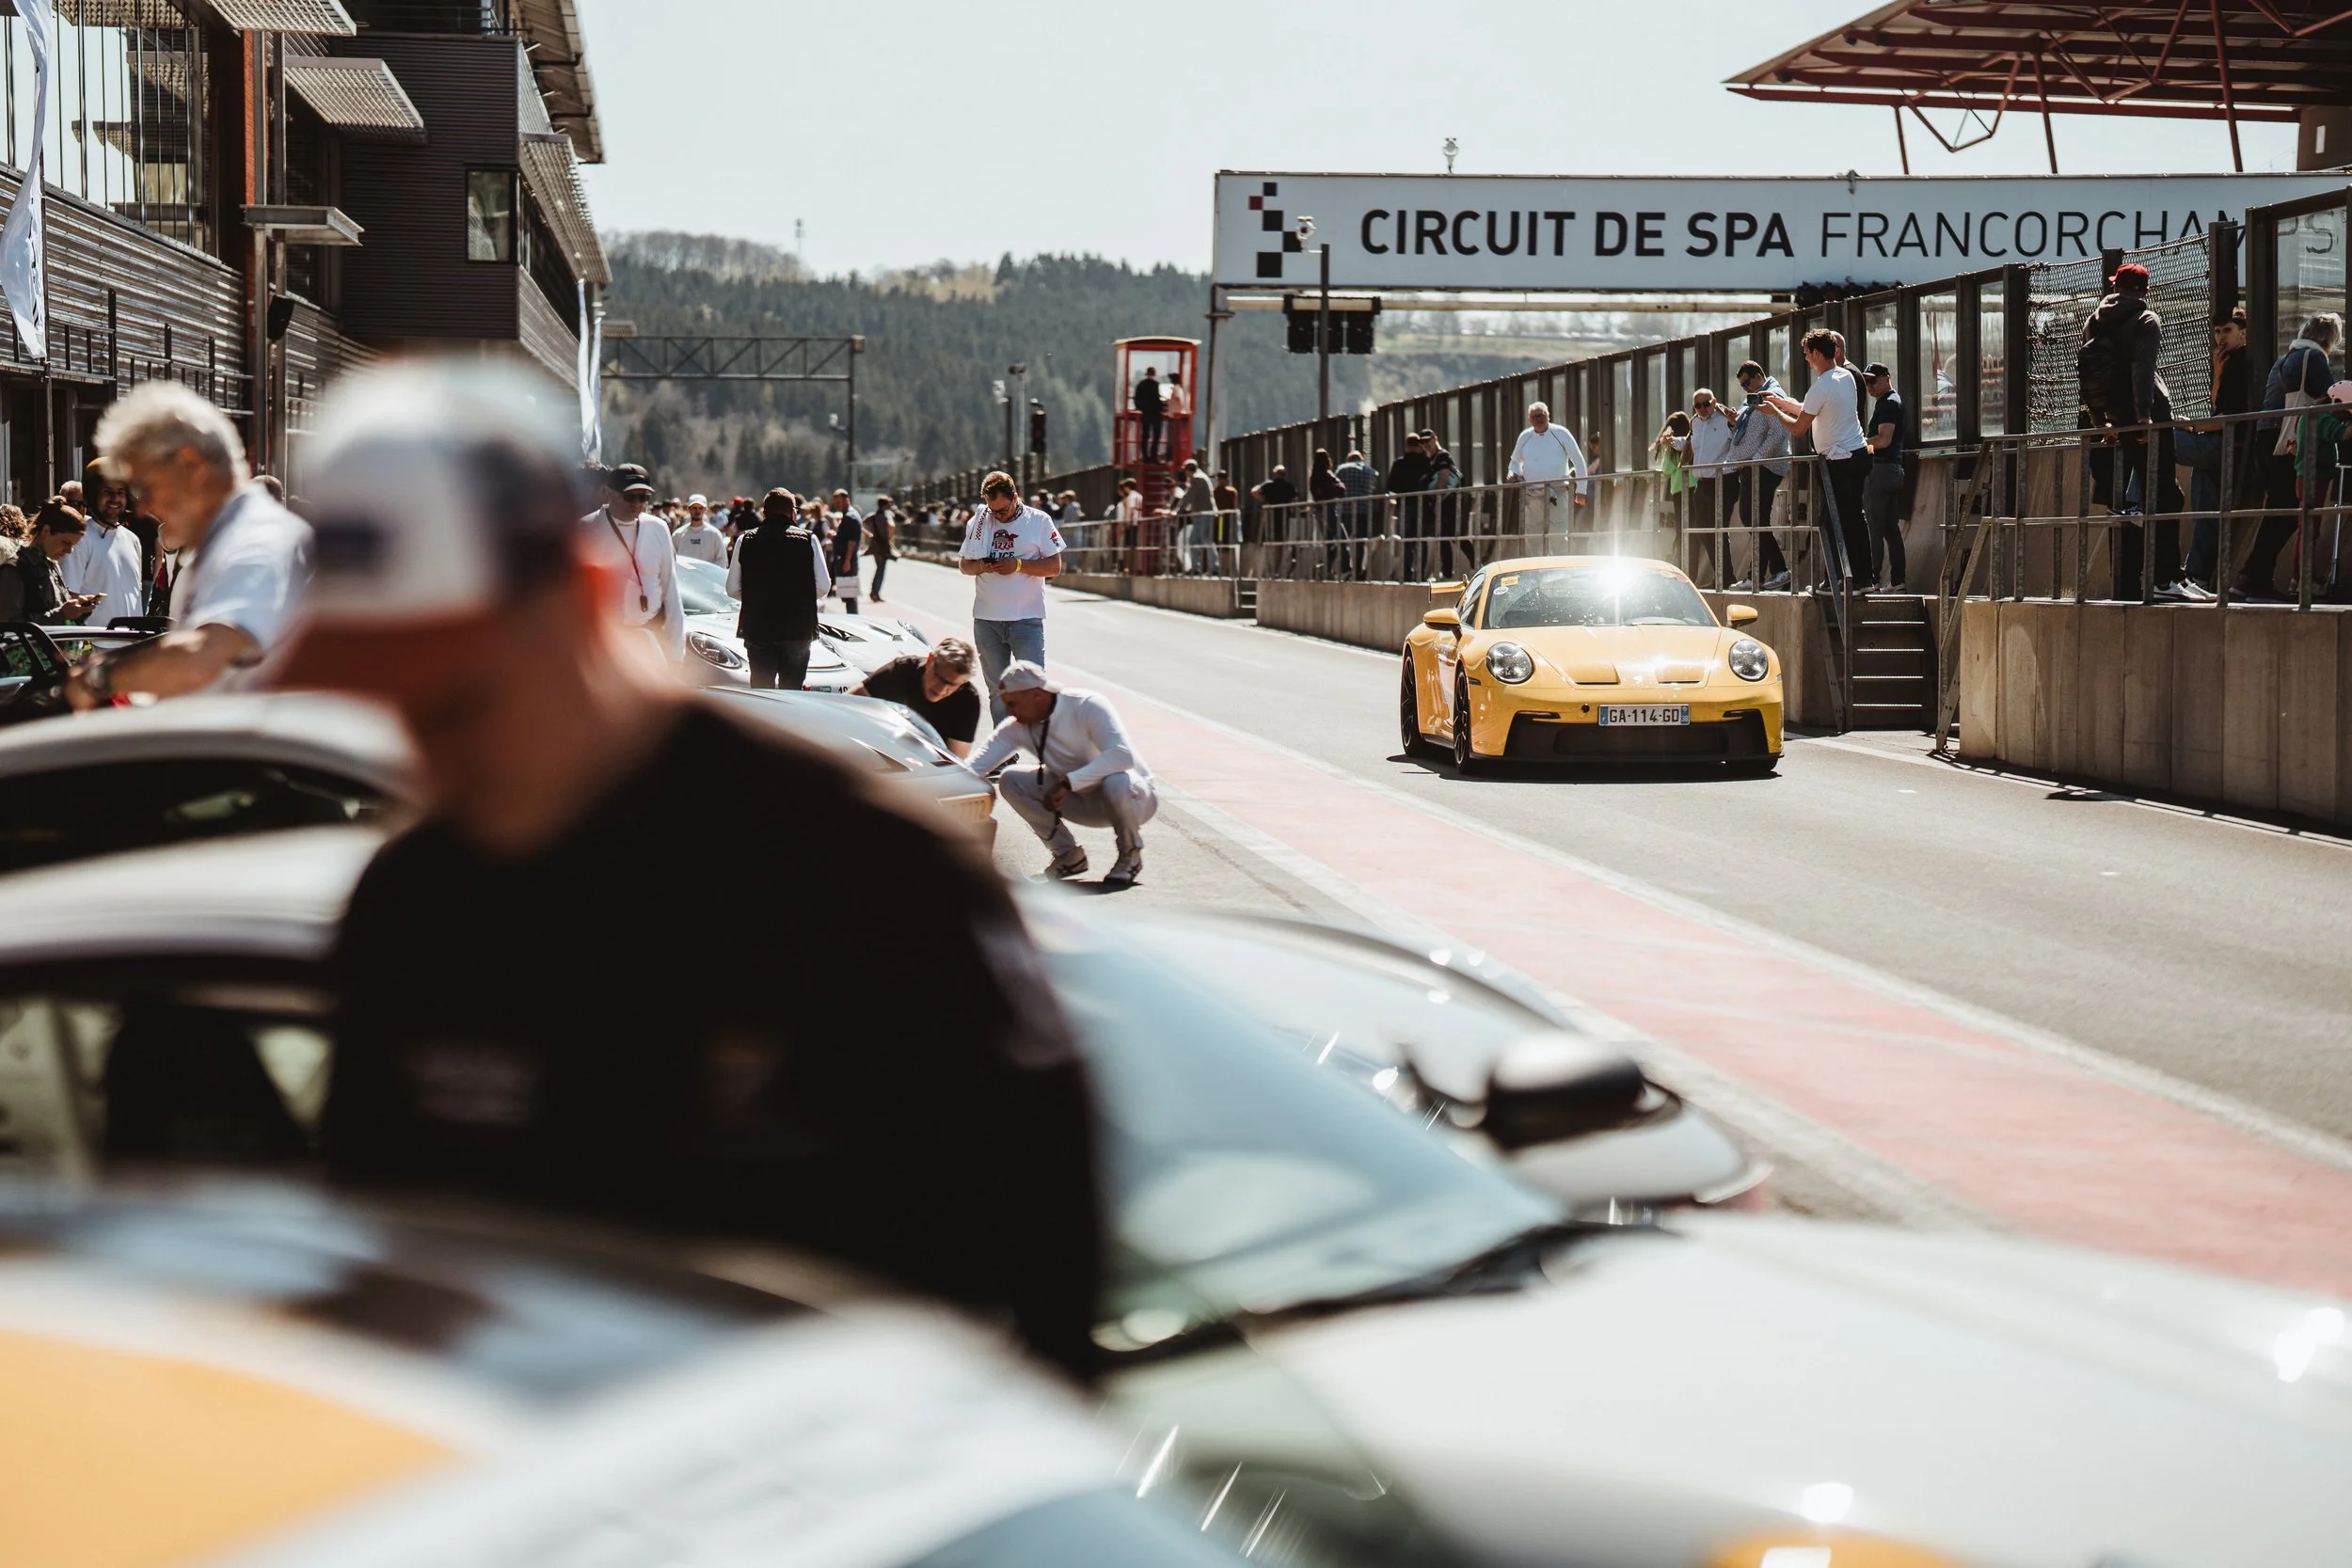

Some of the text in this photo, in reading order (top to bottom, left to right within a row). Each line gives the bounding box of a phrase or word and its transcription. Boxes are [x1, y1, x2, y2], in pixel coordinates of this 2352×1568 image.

[1360, 207, 2334, 258] CIRCUIT DE SPA FRANCORCHAS
[1610, 709, 1679, 723] GA-114-GD
